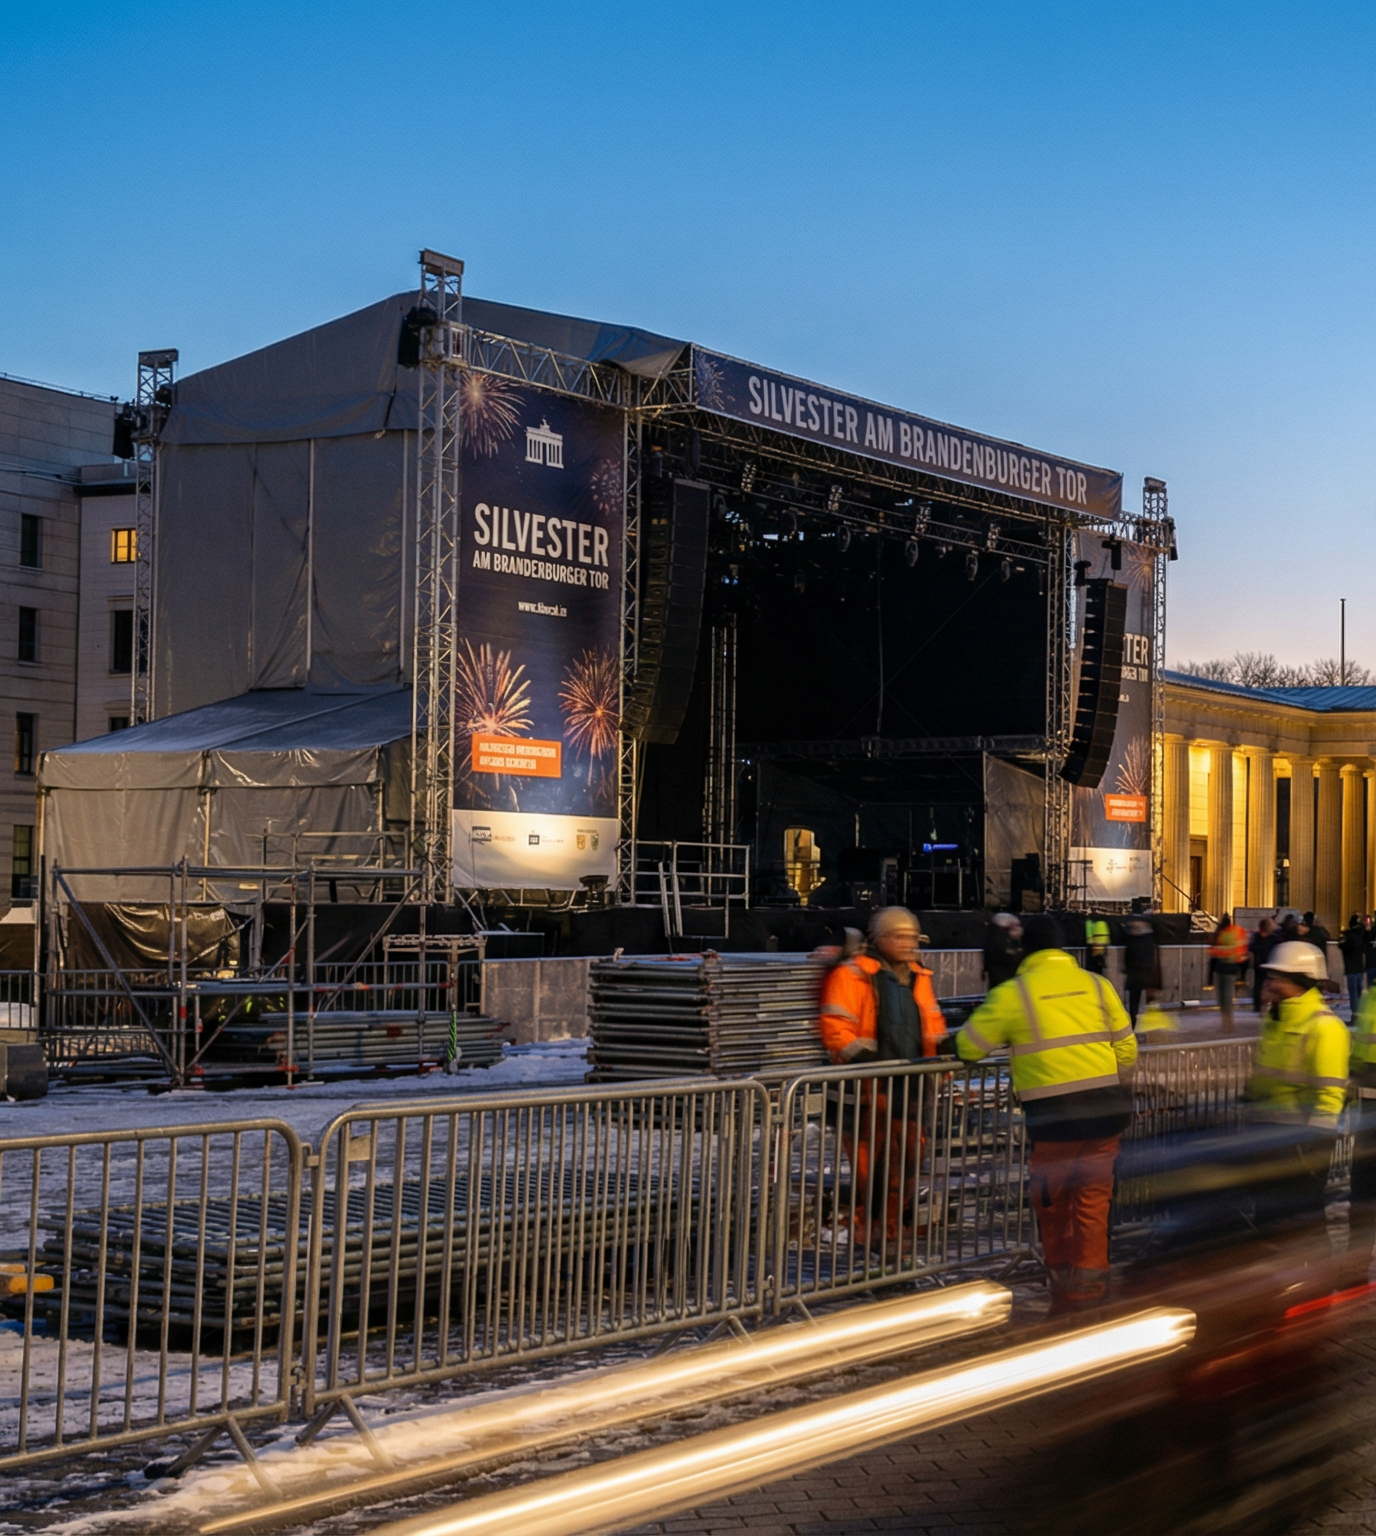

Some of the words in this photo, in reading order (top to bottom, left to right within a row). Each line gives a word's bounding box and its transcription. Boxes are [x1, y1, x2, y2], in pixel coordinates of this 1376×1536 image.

[748, 375, 859, 444] SILVESTER
[864, 412, 894, 454] AM
[899, 421, 1052, 497] BRANDENBURGER
[1055, 466, 1088, 506] TOR
[473, 502, 610, 568] SILVESTER
[472, 549, 491, 570] AM
[588, 570, 610, 590] TOR
